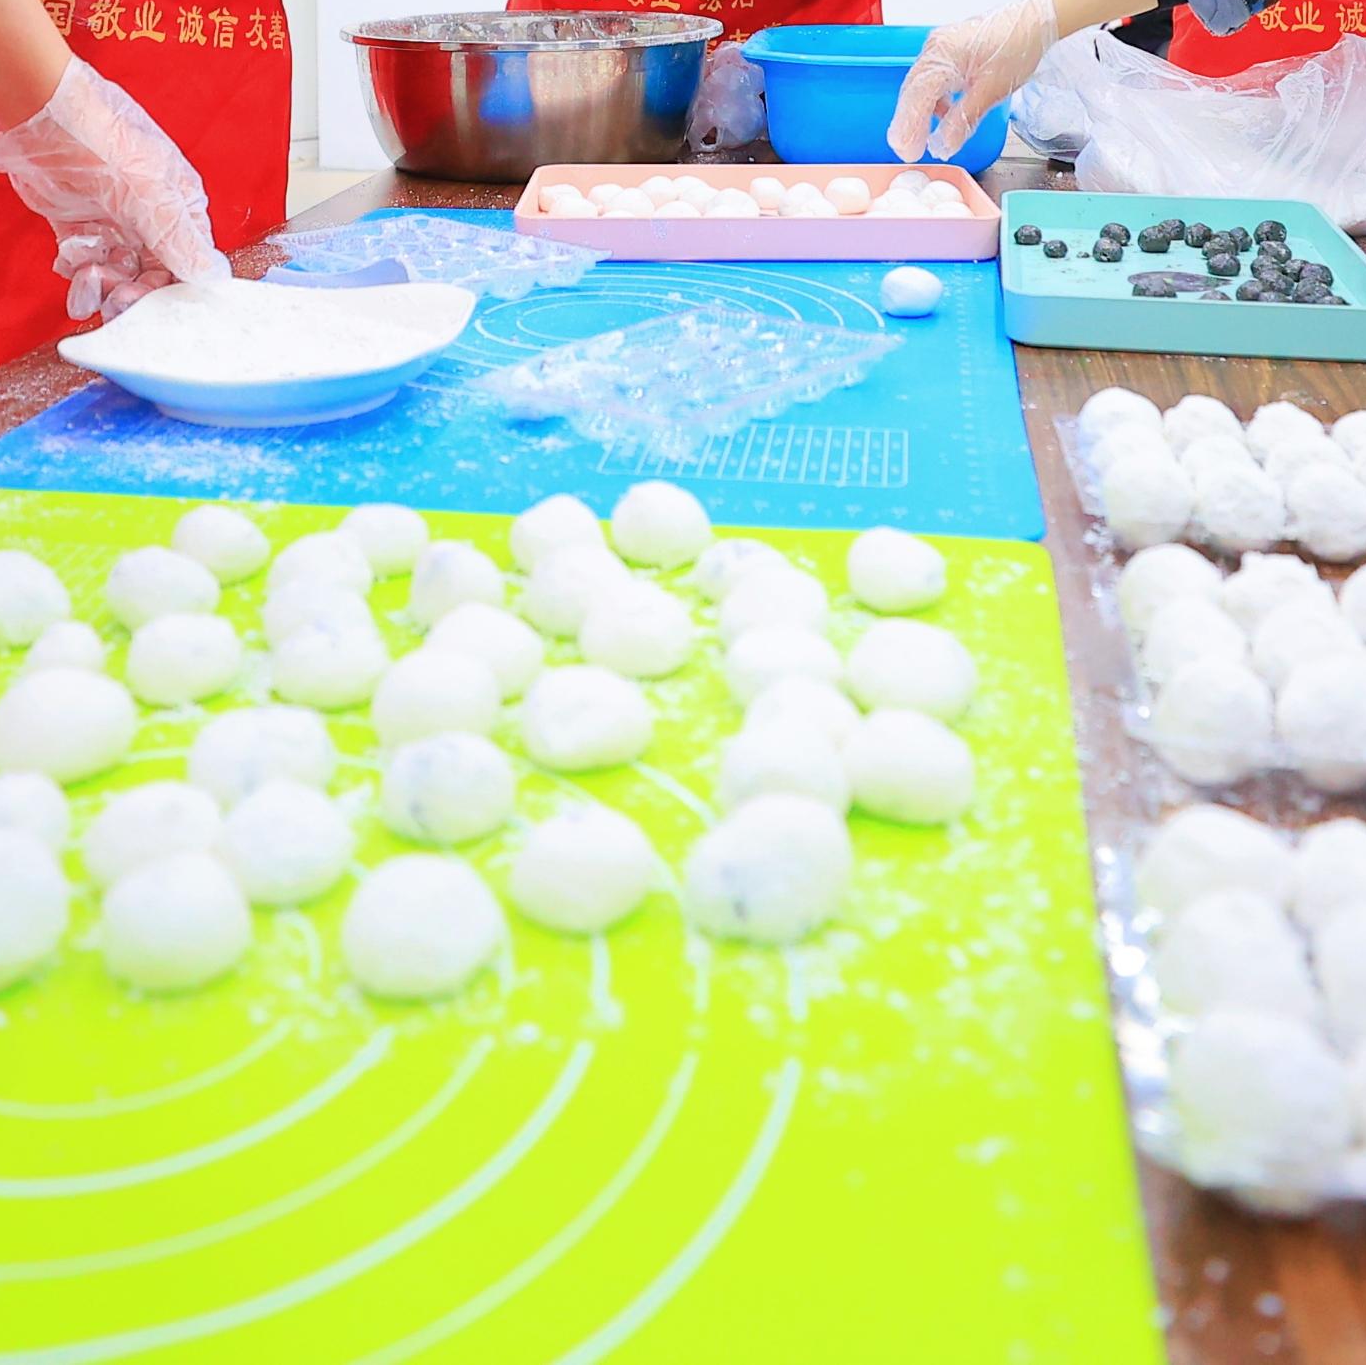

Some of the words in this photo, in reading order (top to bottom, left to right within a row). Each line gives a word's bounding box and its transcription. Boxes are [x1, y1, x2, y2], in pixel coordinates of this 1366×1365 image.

[176, 5, 239, 49] 诚信
[245, 7, 286, 50] 友善
[1257, 1, 1326, 33] 敬业
